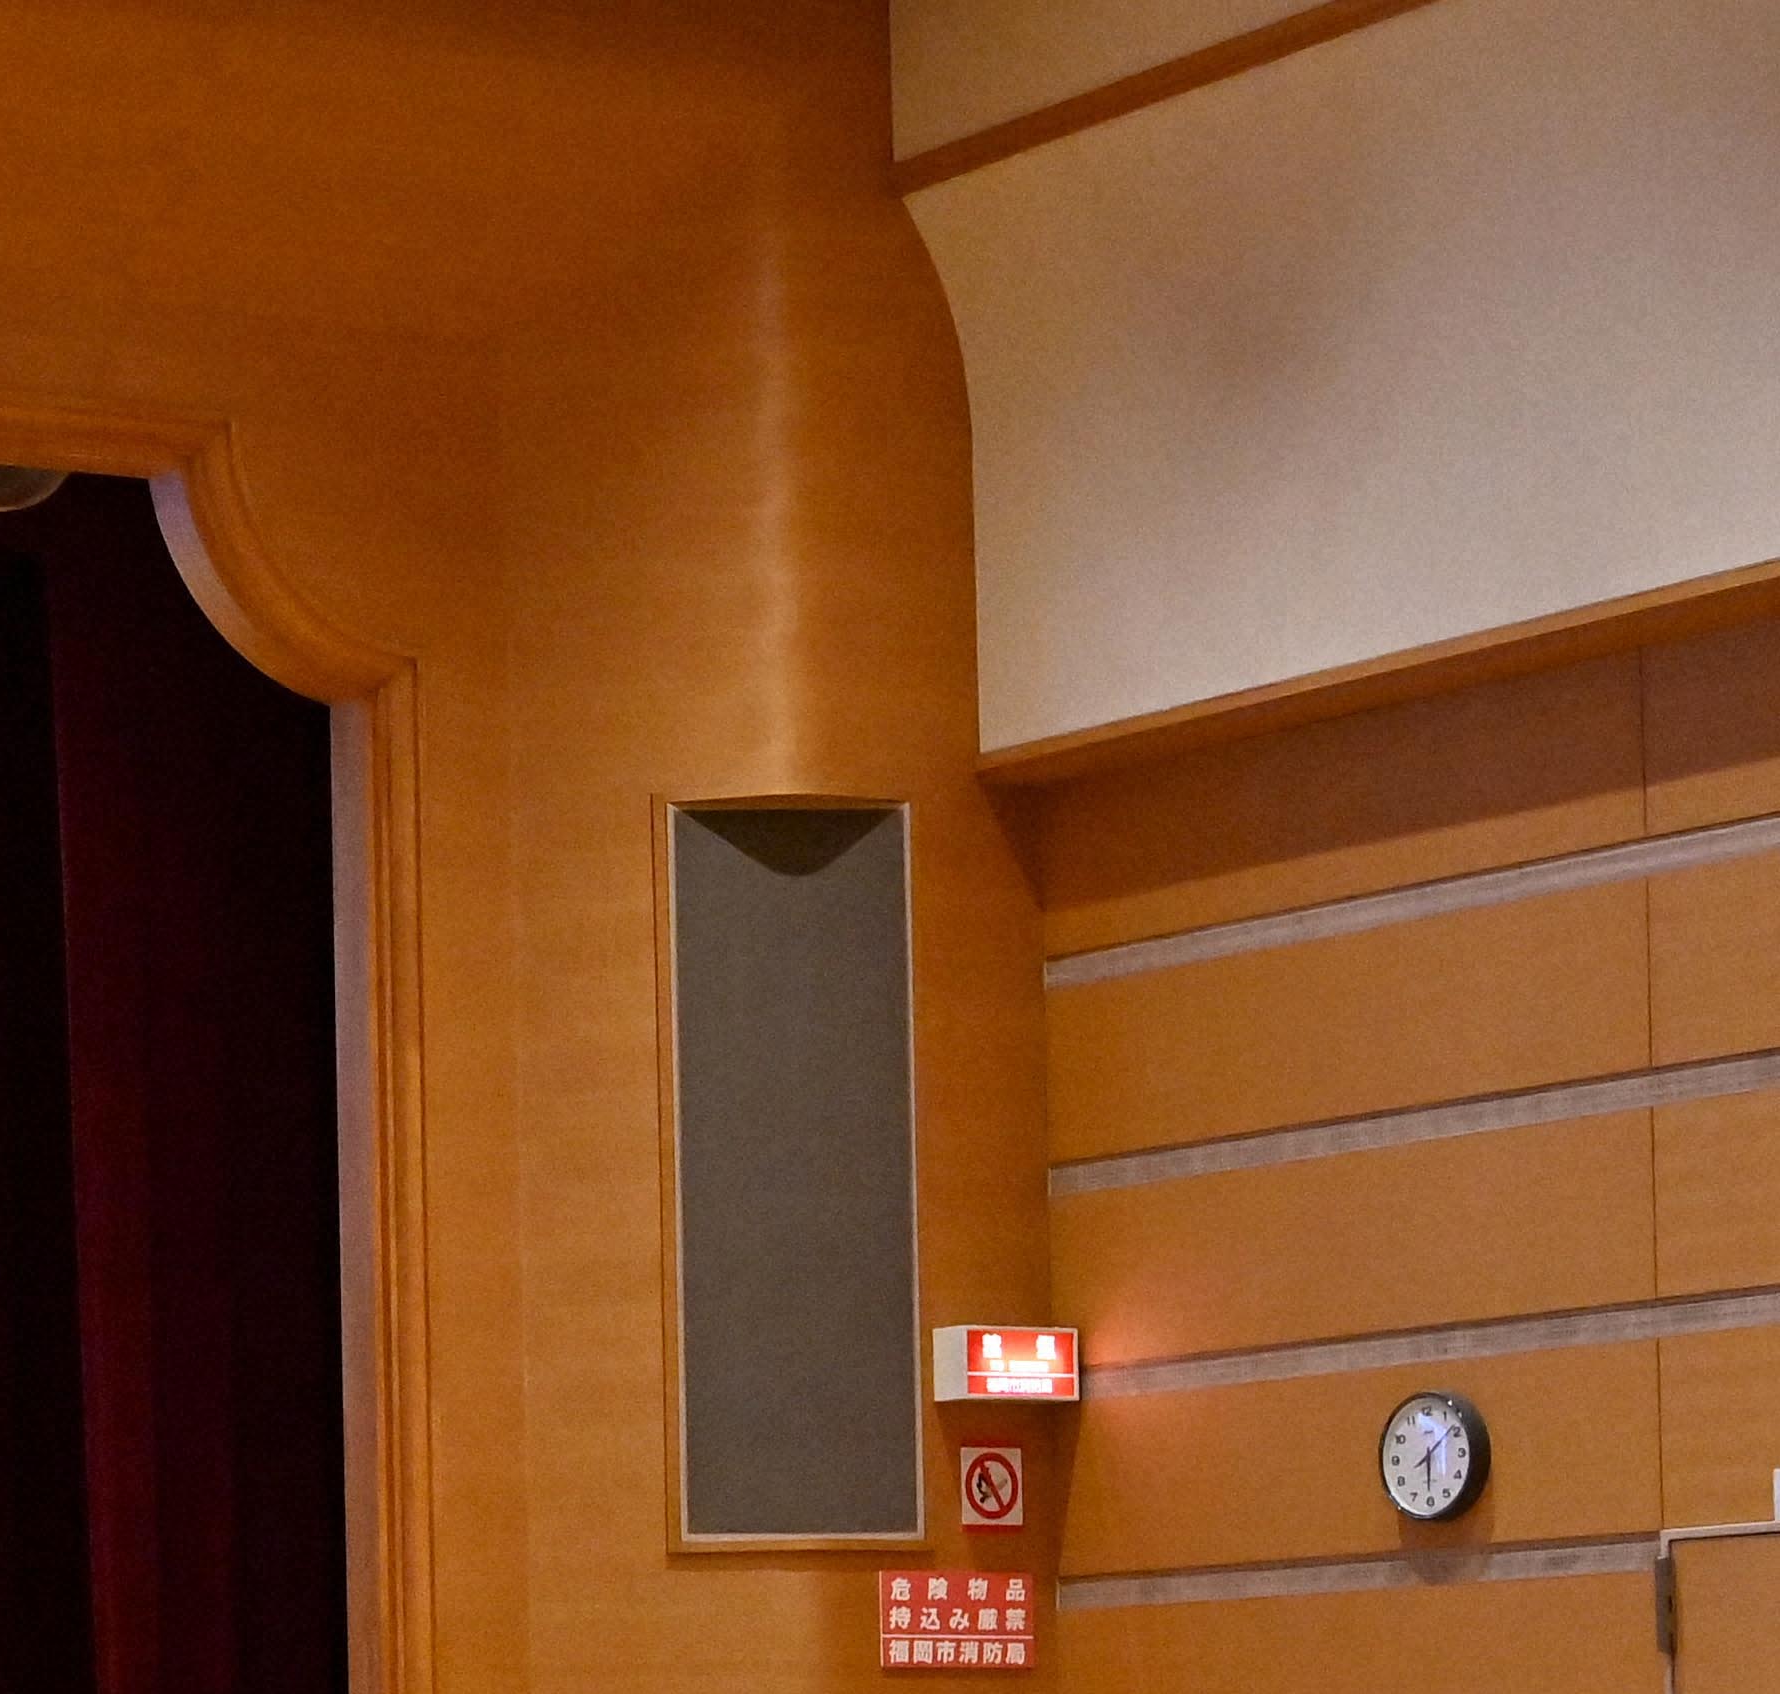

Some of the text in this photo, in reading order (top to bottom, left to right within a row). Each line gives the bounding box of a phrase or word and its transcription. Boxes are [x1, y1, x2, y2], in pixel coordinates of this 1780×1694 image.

[1453, 1426, 1461, 1438] 2
[1395, 1434, 1406, 1445] 10
[1458, 1447, 1466, 1458] 3
[1453, 1469, 1462, 1479] 4
[1410, 1492, 1418, 1502] 7
[1442, 1488, 1451, 1499] 5
[1426, 1496, 1435, 1507] 6
[890, 1576, 1026, 1602] 危険物品
[889, 1606, 1026, 1631] 持込み厳禁
[889, 1639, 1026, 1665] 福岡市消防局
